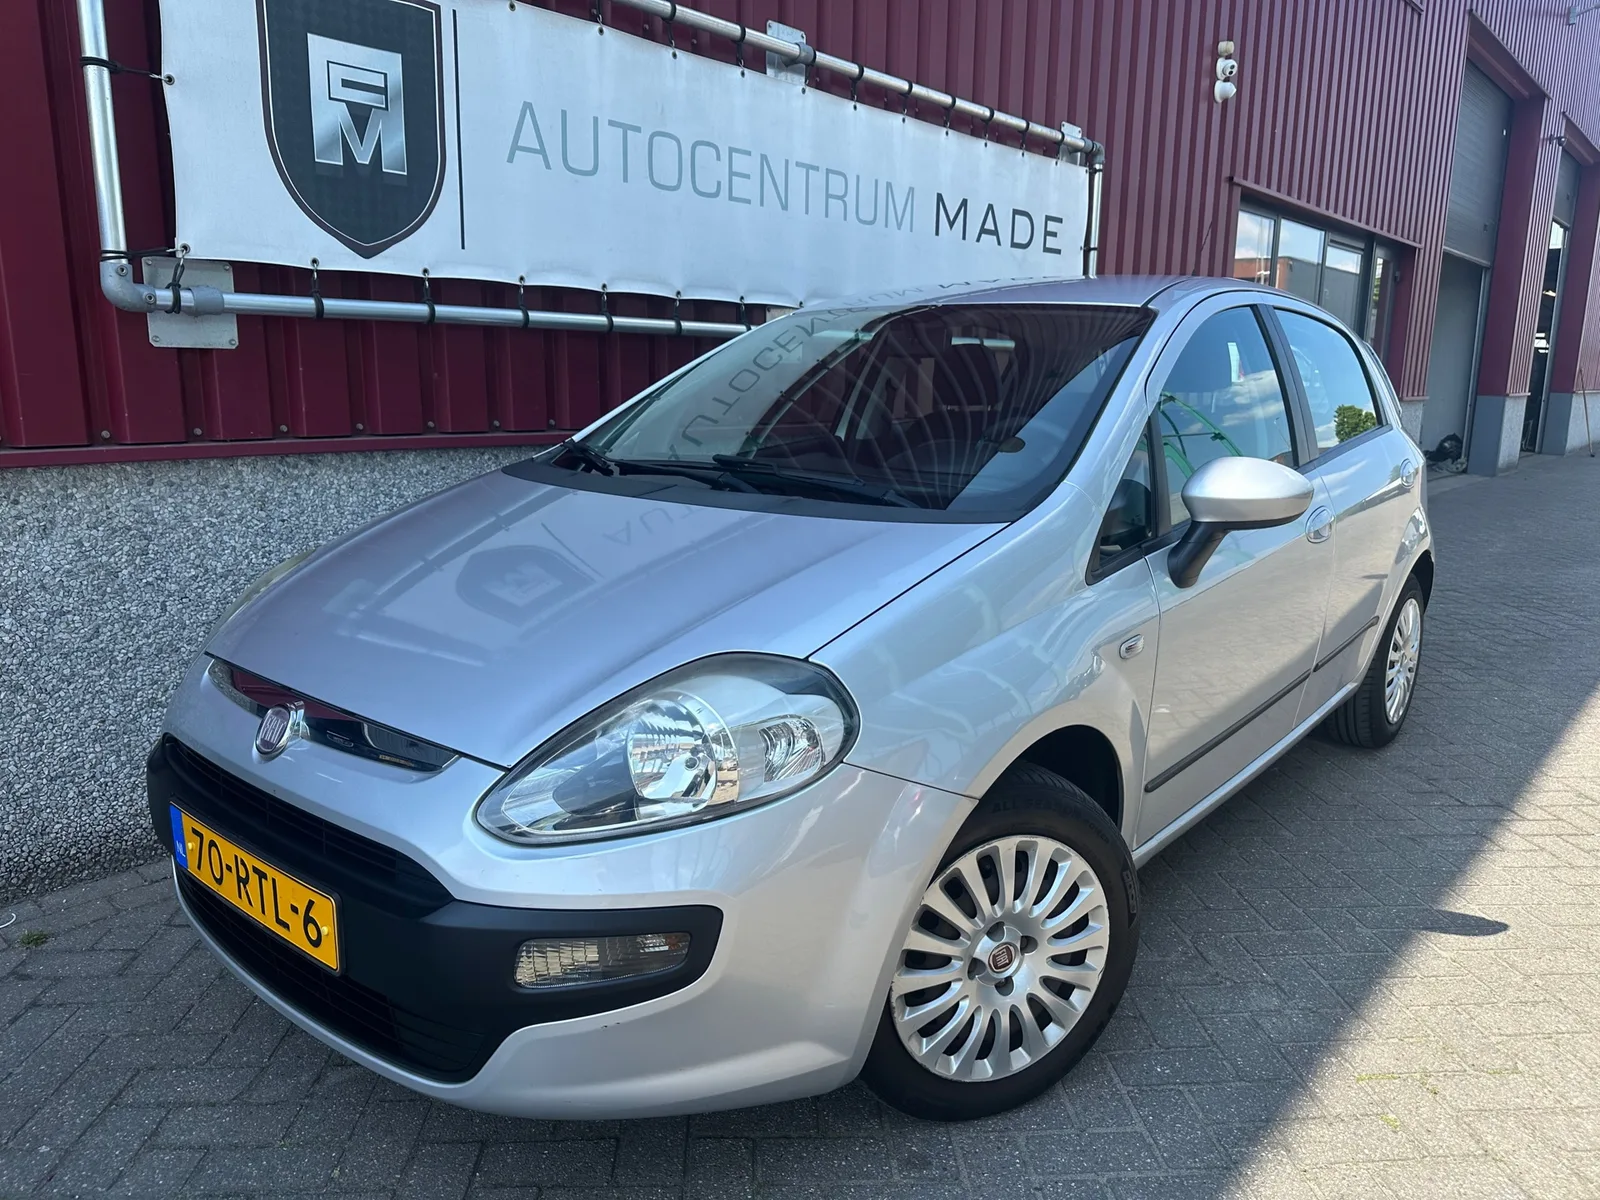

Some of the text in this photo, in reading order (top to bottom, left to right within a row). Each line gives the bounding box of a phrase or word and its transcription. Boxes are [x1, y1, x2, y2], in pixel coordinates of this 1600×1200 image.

[507, 101, 1064, 255] AUTOCENTRUM MADE
[191, 827, 323, 948] 70-RTL-6
[994, 948, 1010, 967] FIAT
